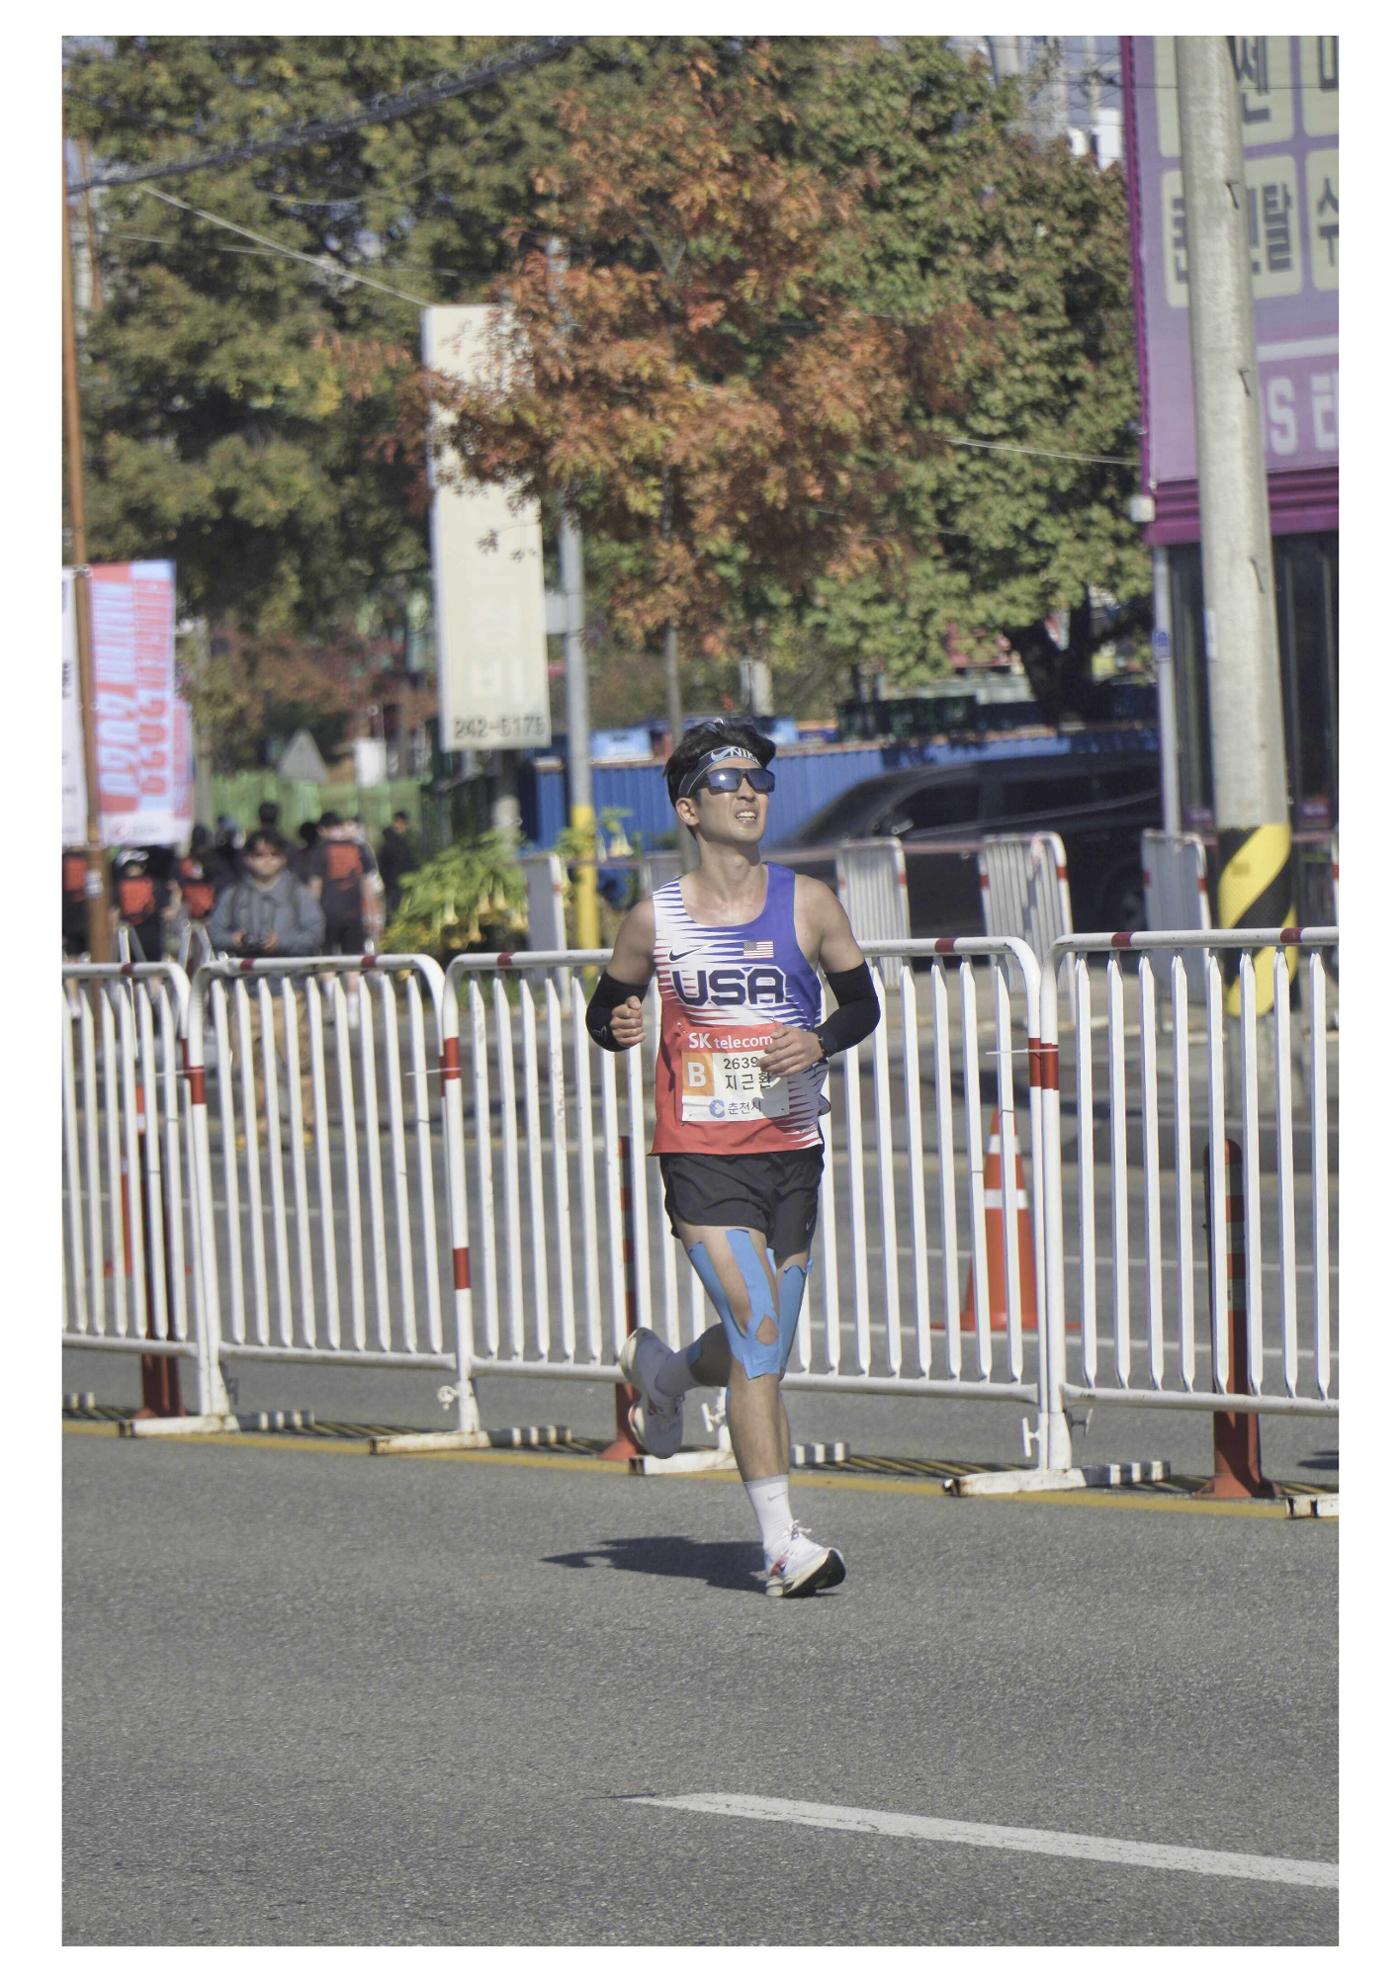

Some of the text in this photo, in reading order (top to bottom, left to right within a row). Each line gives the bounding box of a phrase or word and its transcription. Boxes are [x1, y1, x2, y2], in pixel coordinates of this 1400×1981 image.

[672, 966, 786, 1007] USA
[688, 1032, 773, 1049] SK telecom
[688, 1062, 706, 1087] B
